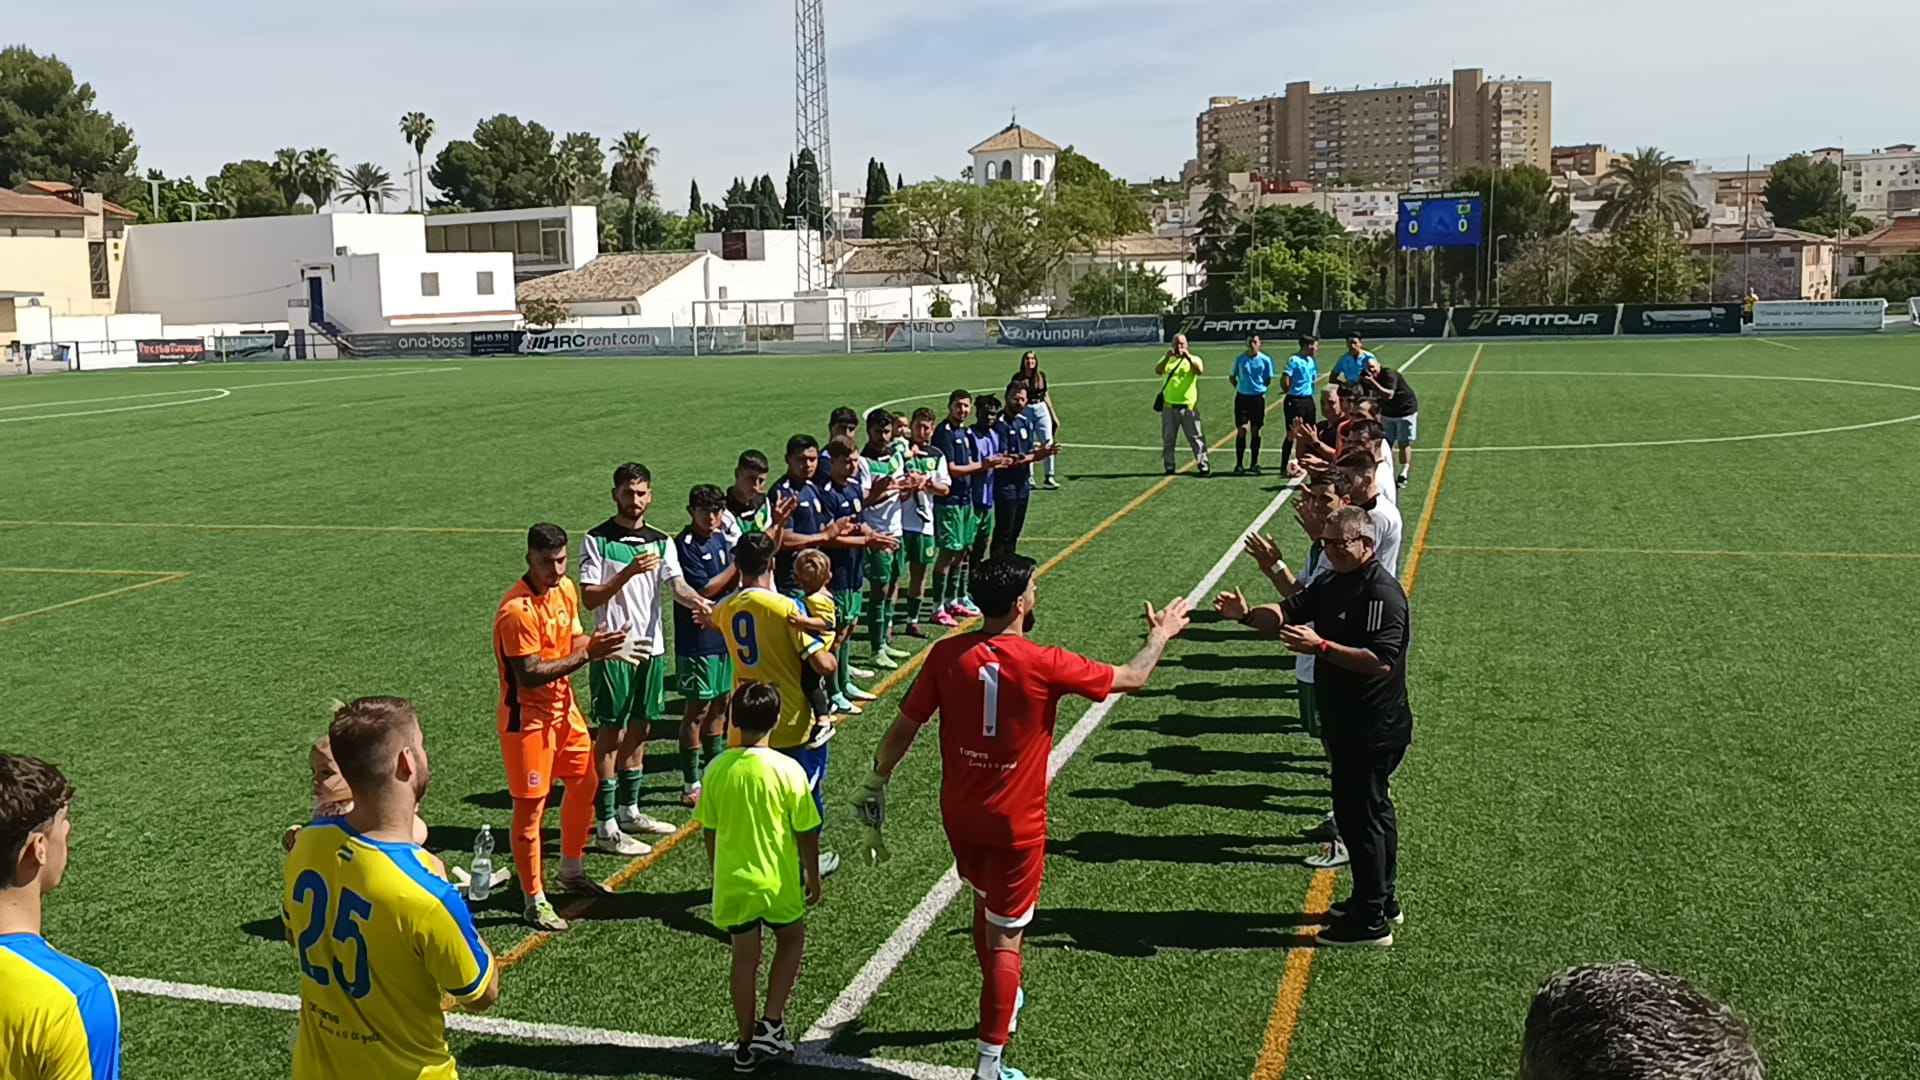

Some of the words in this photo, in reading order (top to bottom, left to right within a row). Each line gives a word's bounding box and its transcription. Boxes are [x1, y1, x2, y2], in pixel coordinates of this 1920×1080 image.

[1408, 220, 1418, 234] 0
[1458, 218, 1468, 232] 0
[1203, 319, 1297, 332] PANTOJA
[1497, 313, 1600, 326] PANTOJA
[1026, 328, 1084, 340] HYUNDAI
[732, 610, 759, 666] 9
[978, 662, 1000, 737] 1
[293, 869, 373, 1000] 25
